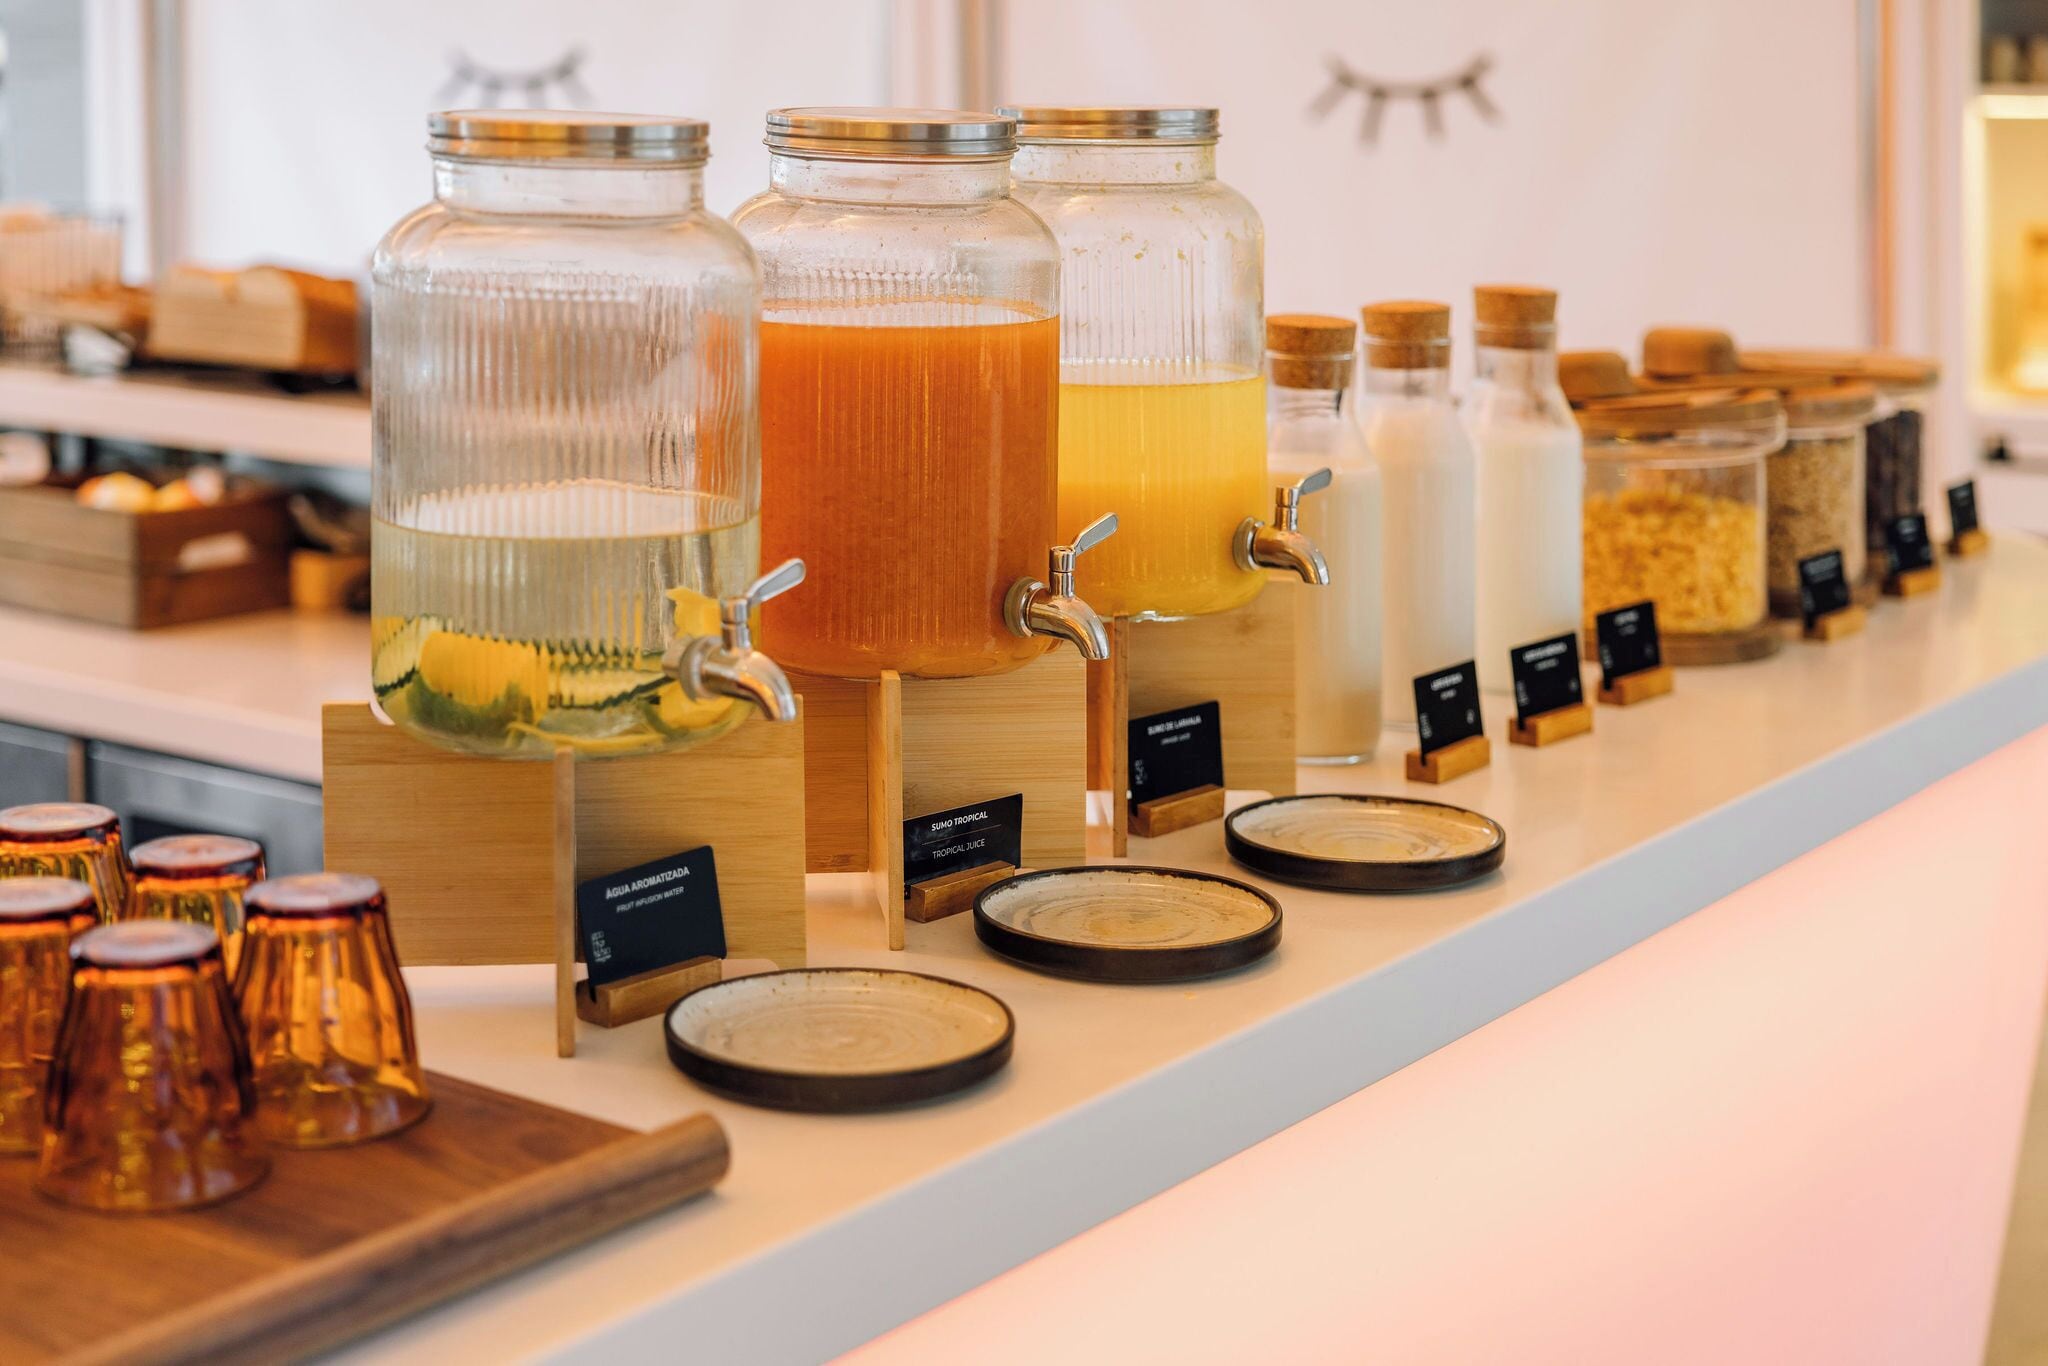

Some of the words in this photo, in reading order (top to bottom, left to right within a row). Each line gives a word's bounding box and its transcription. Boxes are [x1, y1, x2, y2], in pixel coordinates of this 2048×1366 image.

[931, 819, 953, 832] SUMO
[954, 811, 988, 826] TROPICAL
[932, 846, 965, 860] TROPICAL
[966, 838, 985, 851] JUICE
[631, 866, 690, 892] AROMATIZADA
[616, 901, 635, 913] FRUIT
[635, 893, 664, 908] INFUSION
[664, 886, 685, 899] WATER
